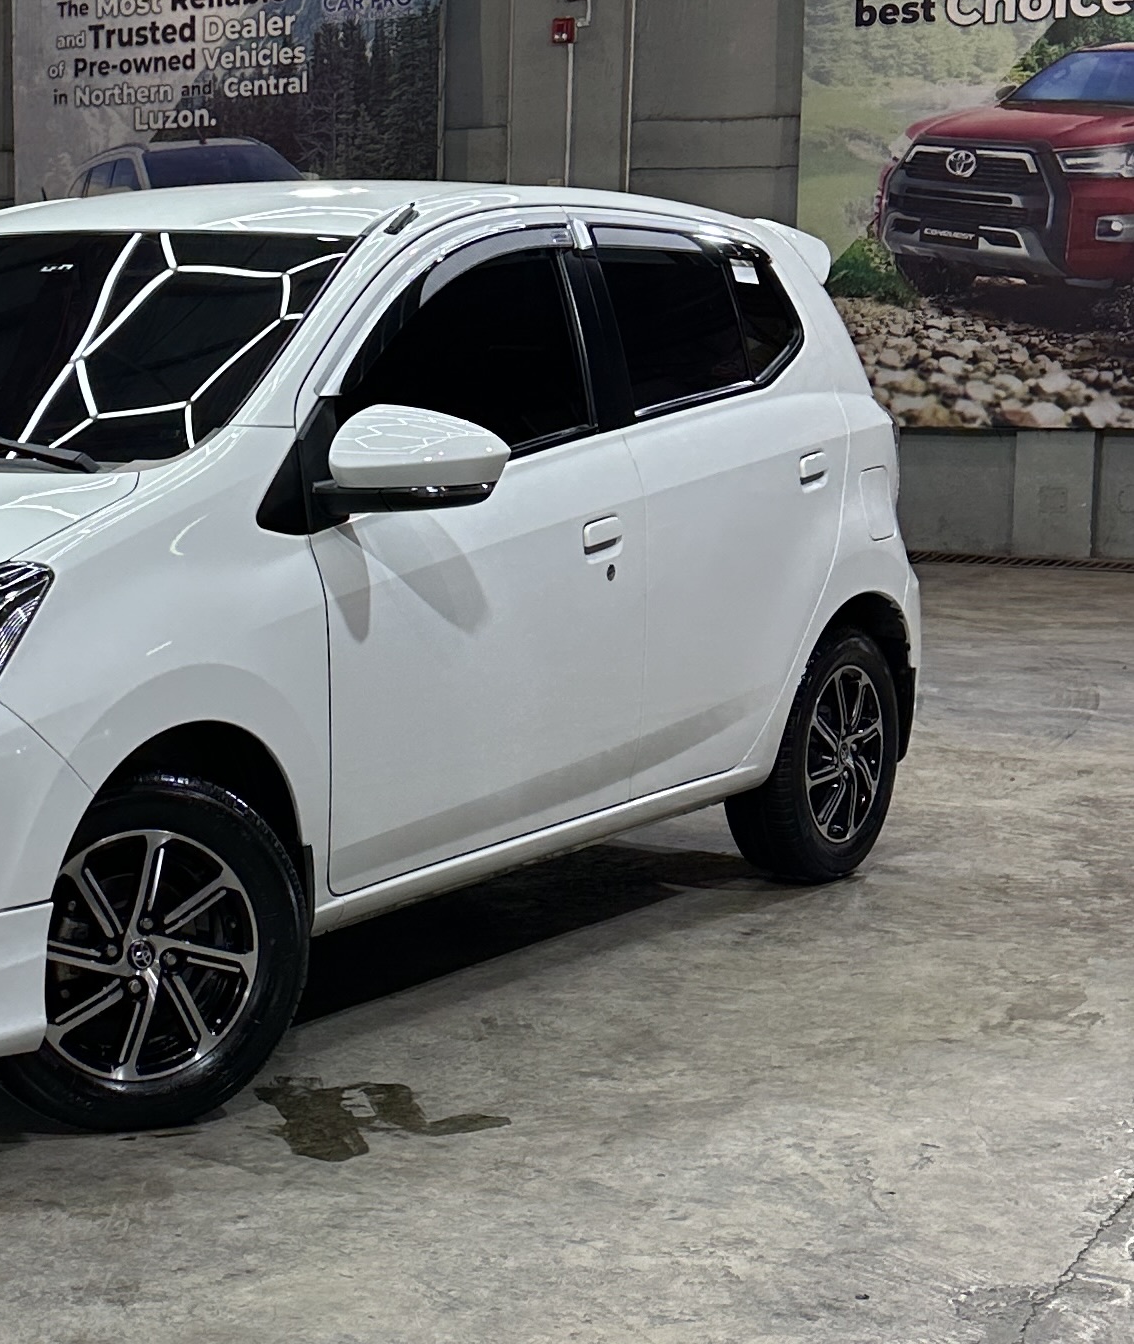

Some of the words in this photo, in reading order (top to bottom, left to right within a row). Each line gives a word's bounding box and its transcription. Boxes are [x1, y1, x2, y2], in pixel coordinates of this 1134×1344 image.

[57, 0, 89, 18] The
[56, 31, 86, 50] and
[88, 15, 196, 49] Trusted
[203, 10, 297, 43] Dealer
[48, 61, 65, 79] of
[74, 48, 196, 78] Pre-owned
[202, 42, 307, 71] Vehicles
[53, 89, 68, 105] in
[74, 82, 174, 107] Northern
[181, 80, 212, 97] and
[223, 70, 309, 99] Central
[133, 107, 217, 131] Luzon.
